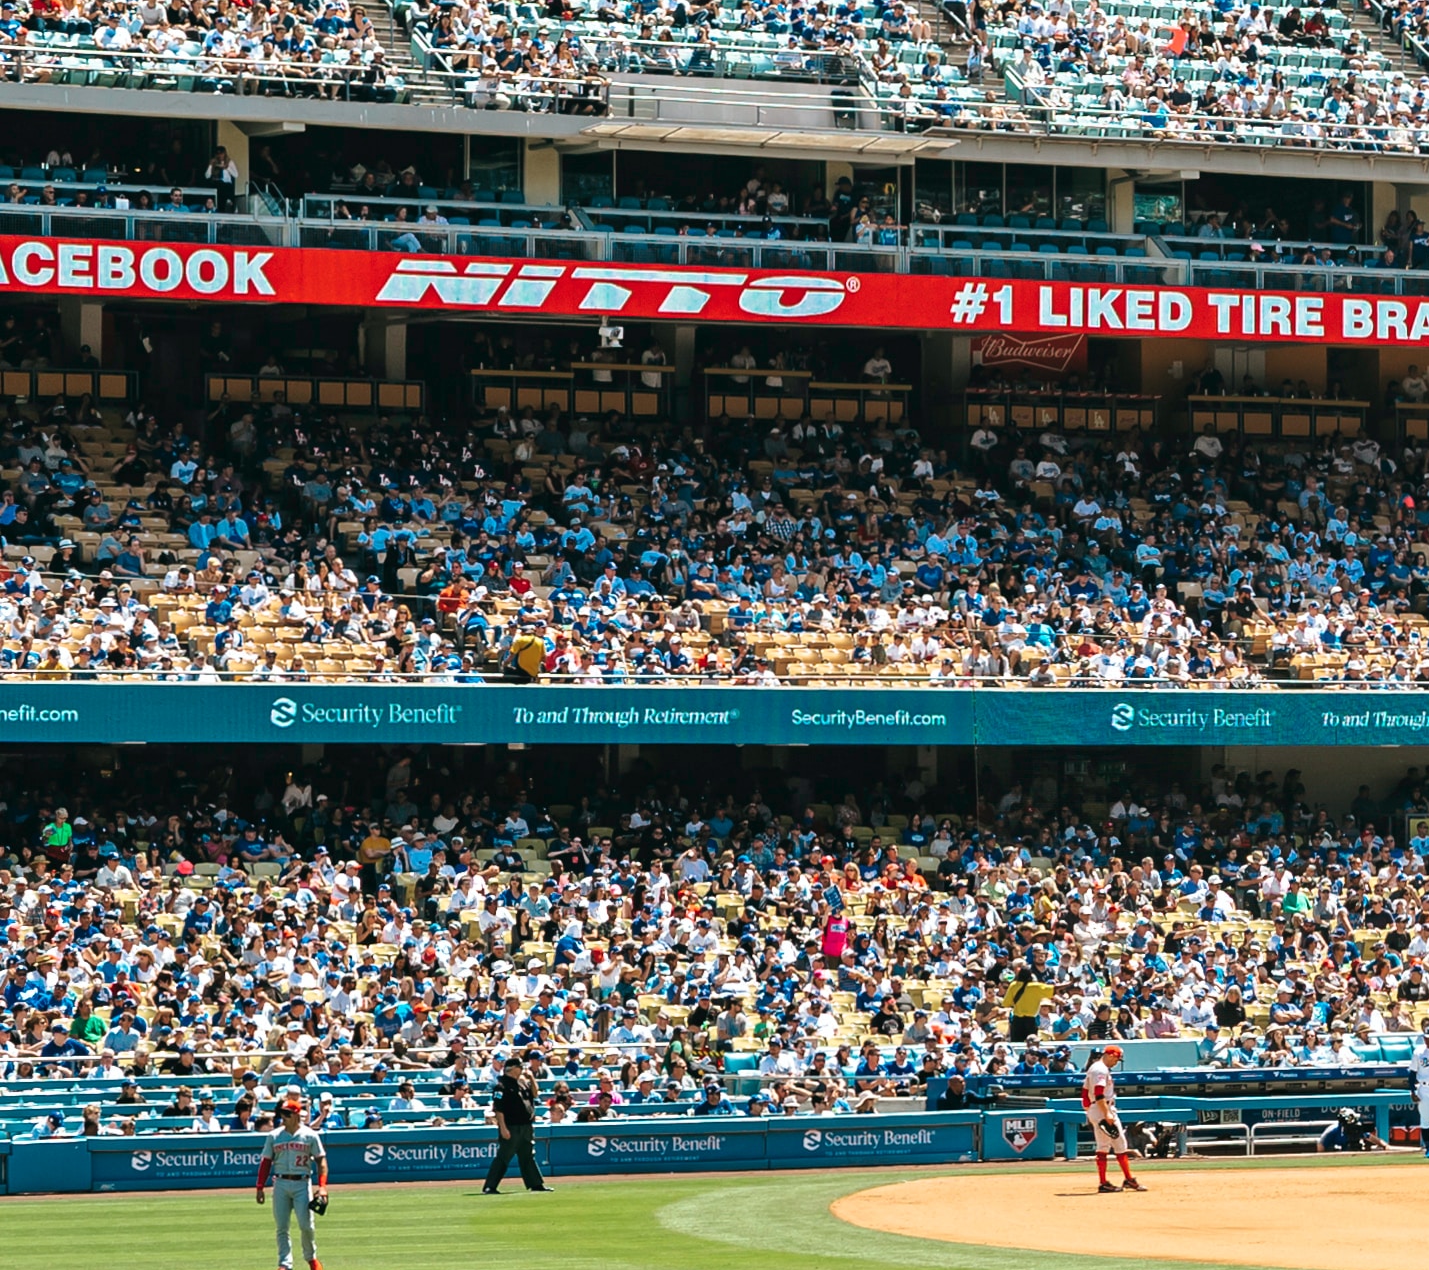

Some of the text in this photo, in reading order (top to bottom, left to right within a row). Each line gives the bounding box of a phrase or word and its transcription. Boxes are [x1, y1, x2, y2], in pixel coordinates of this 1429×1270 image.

[0, 241, 275, 296] CEBOOK
[951, 282, 1014, 325] #1
[1038, 286, 1192, 331] LIKED
[1207, 293, 1325, 338] TIRE
[982, 334, 1074, 359] Budweiser
[302, 704, 382, 728] Security
[513, 707, 534, 724] To
[537, 707, 568, 724] and
[572, 707, 640, 727] Through
[791, 708, 946, 730] SecurityBenefit.com
[1138, 708, 1209, 731] Security
[1322, 712, 1339, 728] To
[1342, 712, 1369, 728] and
[1321, 1105, 1370, 1114] DOER
[1006, 1120, 1034, 1130] MLB
[610, 1137, 669, 1155] Security
[825, 1131, 881, 1150] Security
[156, 1149, 263, 1169] Security Bene
[295, 1155, 309, 1167] 22
[387, 1142, 500, 1163] Security Benefi
